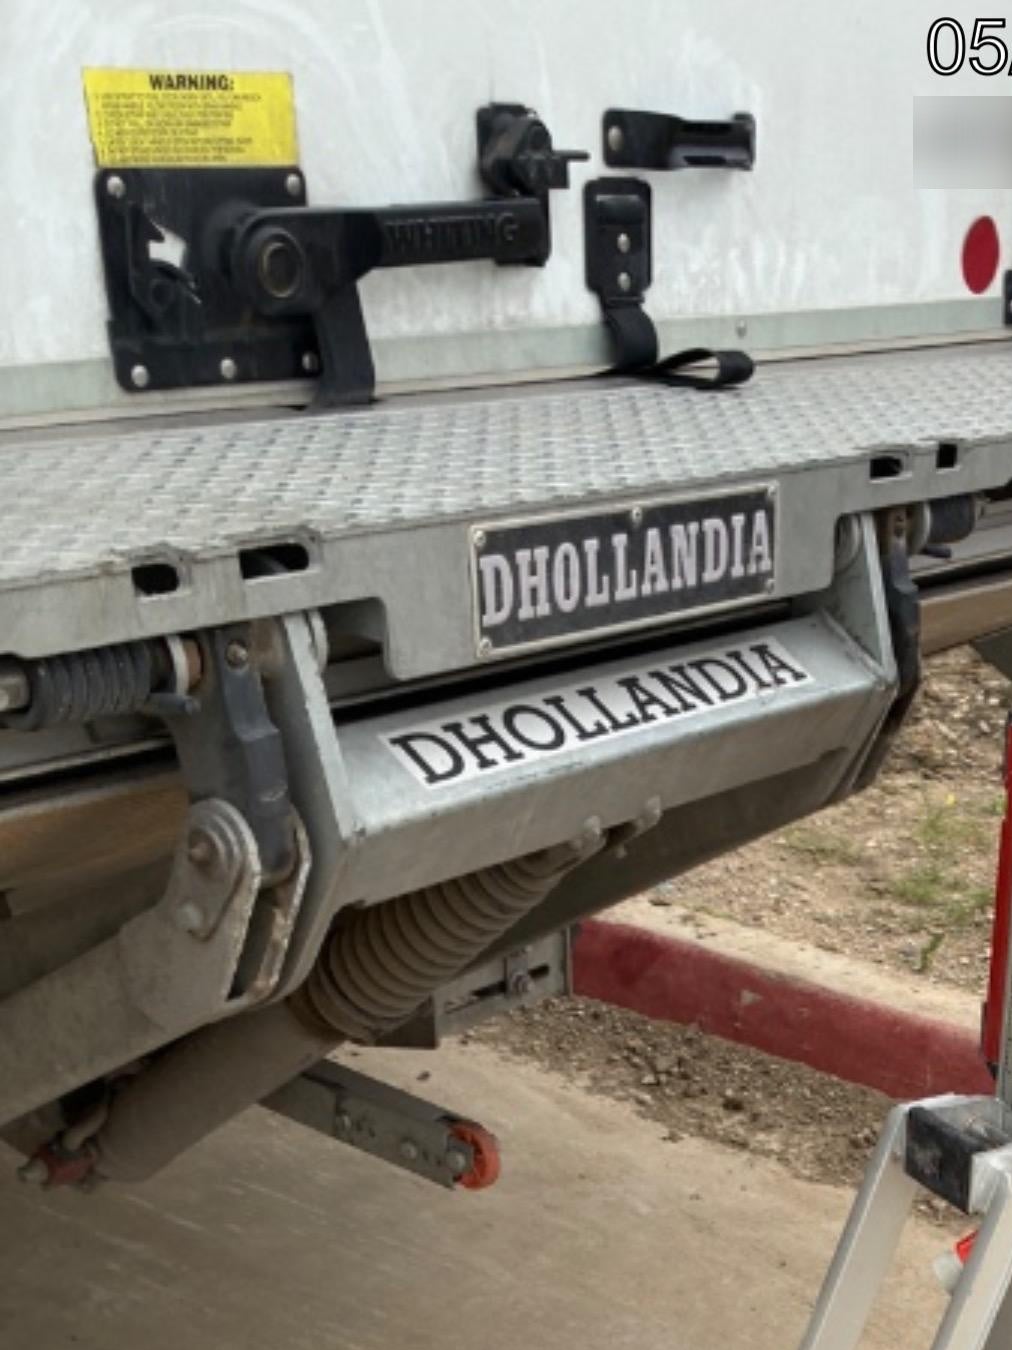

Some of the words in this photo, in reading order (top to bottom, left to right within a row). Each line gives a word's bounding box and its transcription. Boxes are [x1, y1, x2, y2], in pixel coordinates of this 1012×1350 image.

[149, 75, 234, 91] WARNING:
[385, 211, 518, 251] WHITING
[479, 509, 773, 627] DHOLLANDIA
[389, 644, 807, 785] DHOLLANDIA
